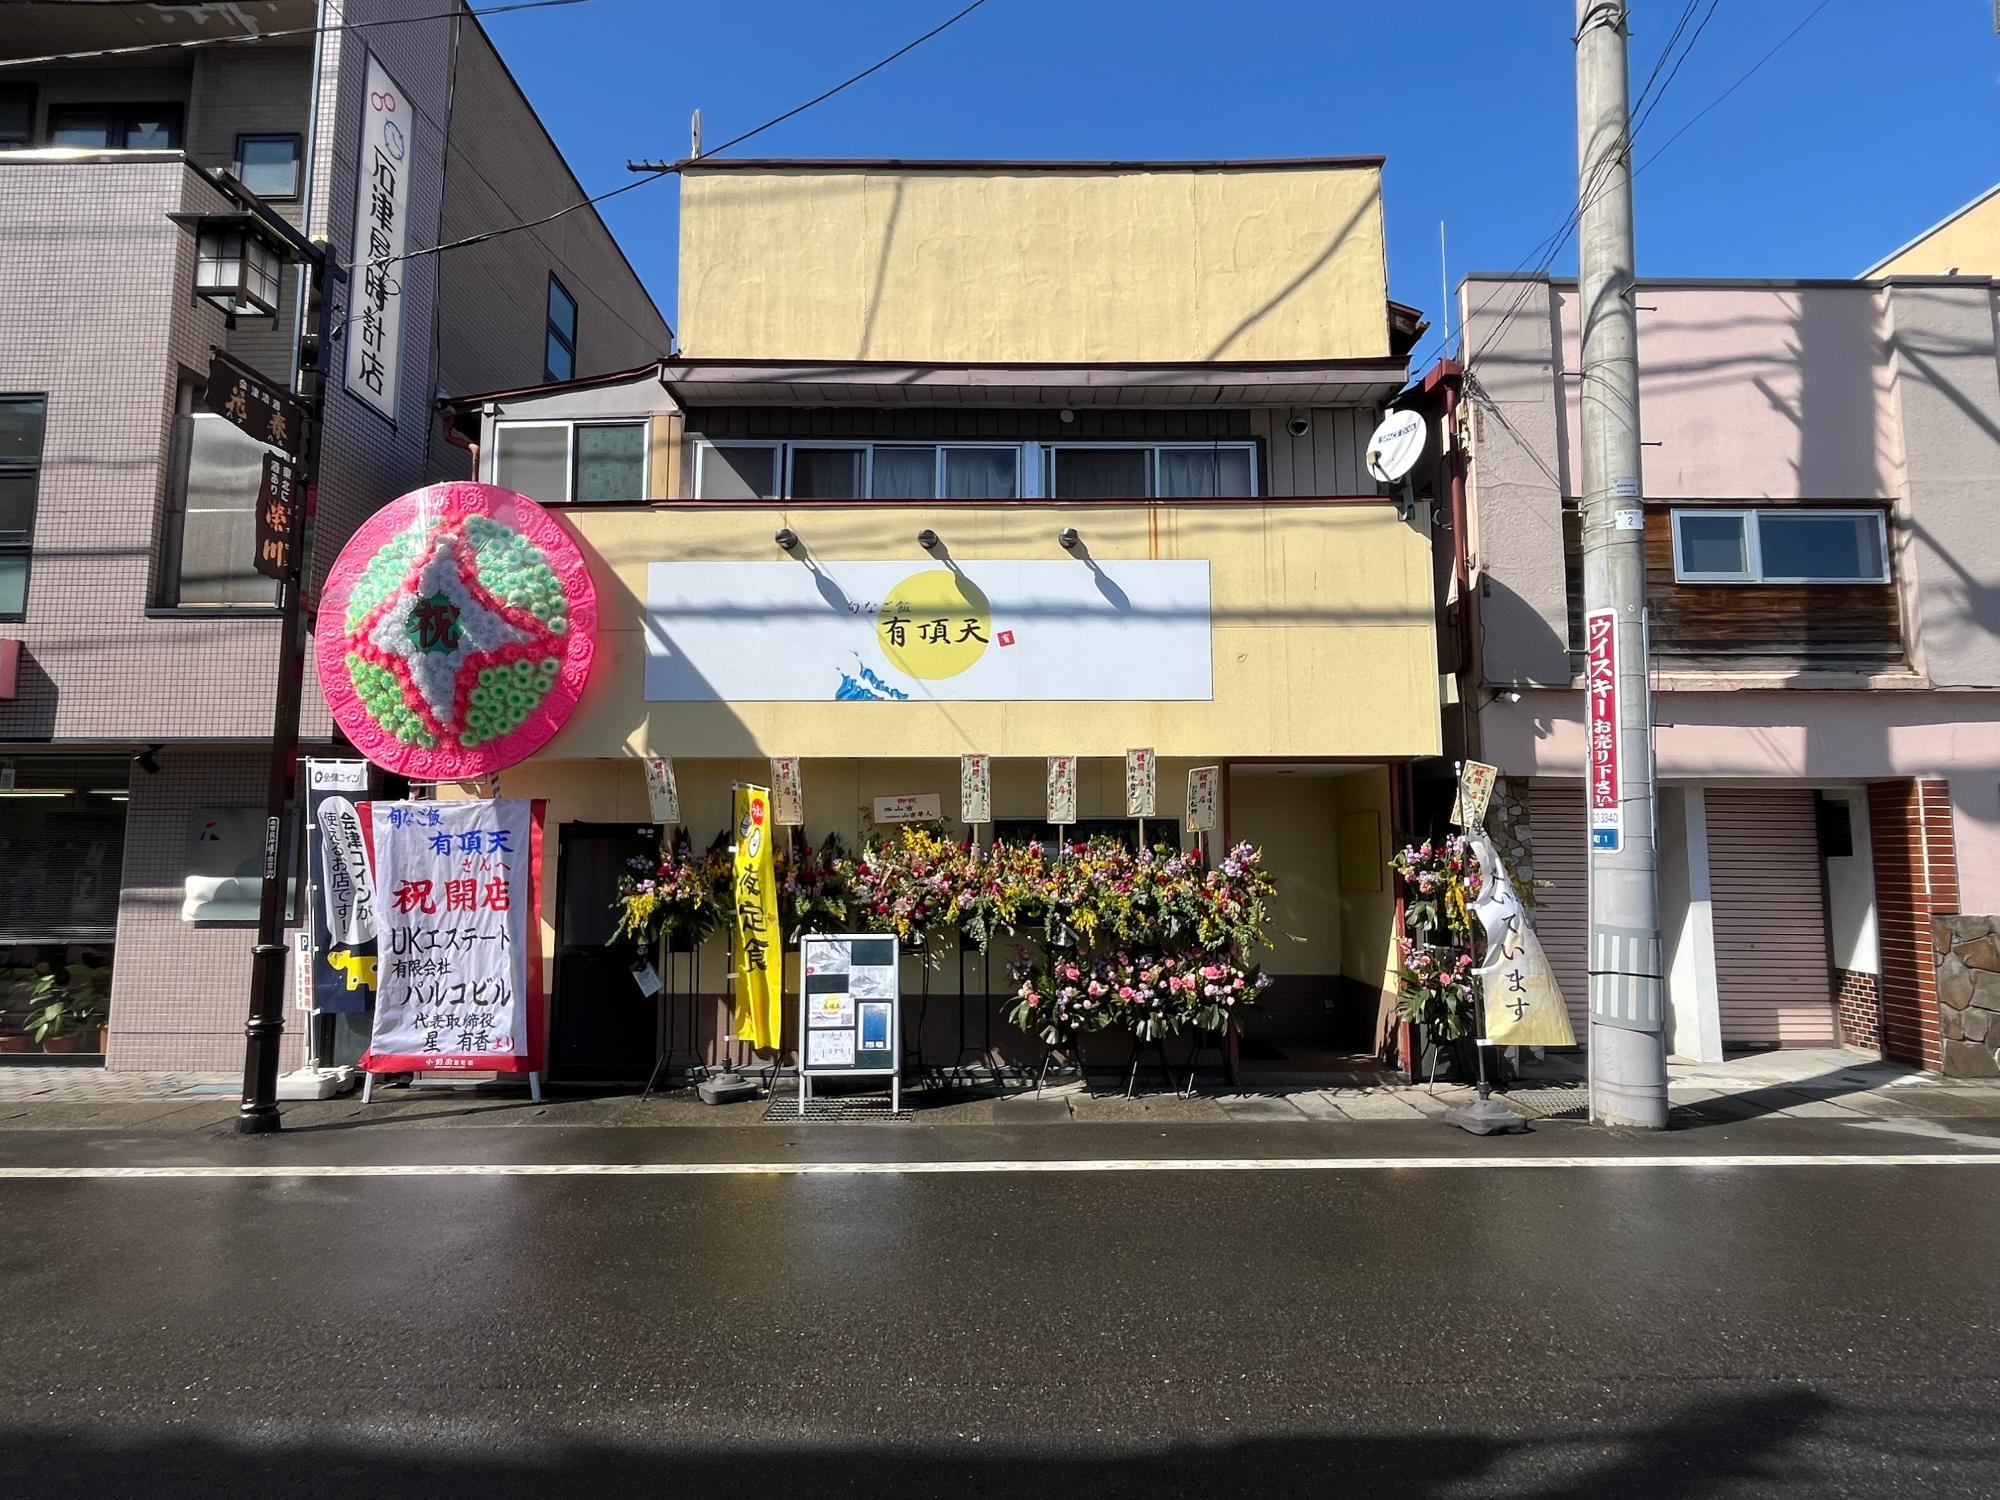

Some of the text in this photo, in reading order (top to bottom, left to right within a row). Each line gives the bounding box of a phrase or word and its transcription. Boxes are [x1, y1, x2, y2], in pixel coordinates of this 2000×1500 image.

[1628, 516, 1634, 526] 2
[848, 600, 912, 614] 旬なご飯
[407, 600, 462, 648] 祝
[882, 616, 990, 648] 有頂天
[387, 806, 444, 829] 旬なご飯
[428, 829, 514, 857] 有頂天
[340, 811, 373, 921] 会津コインが
[462, 858, 511, 873] さんへ
[391, 924, 511, 955] UKエステート
[391, 958, 451, 978] 有限会社
[400, 978, 511, 1008] パルコビル
[413, 1013, 497, 1030] 代表取締役
[423, 1031, 441, 1053] 星
